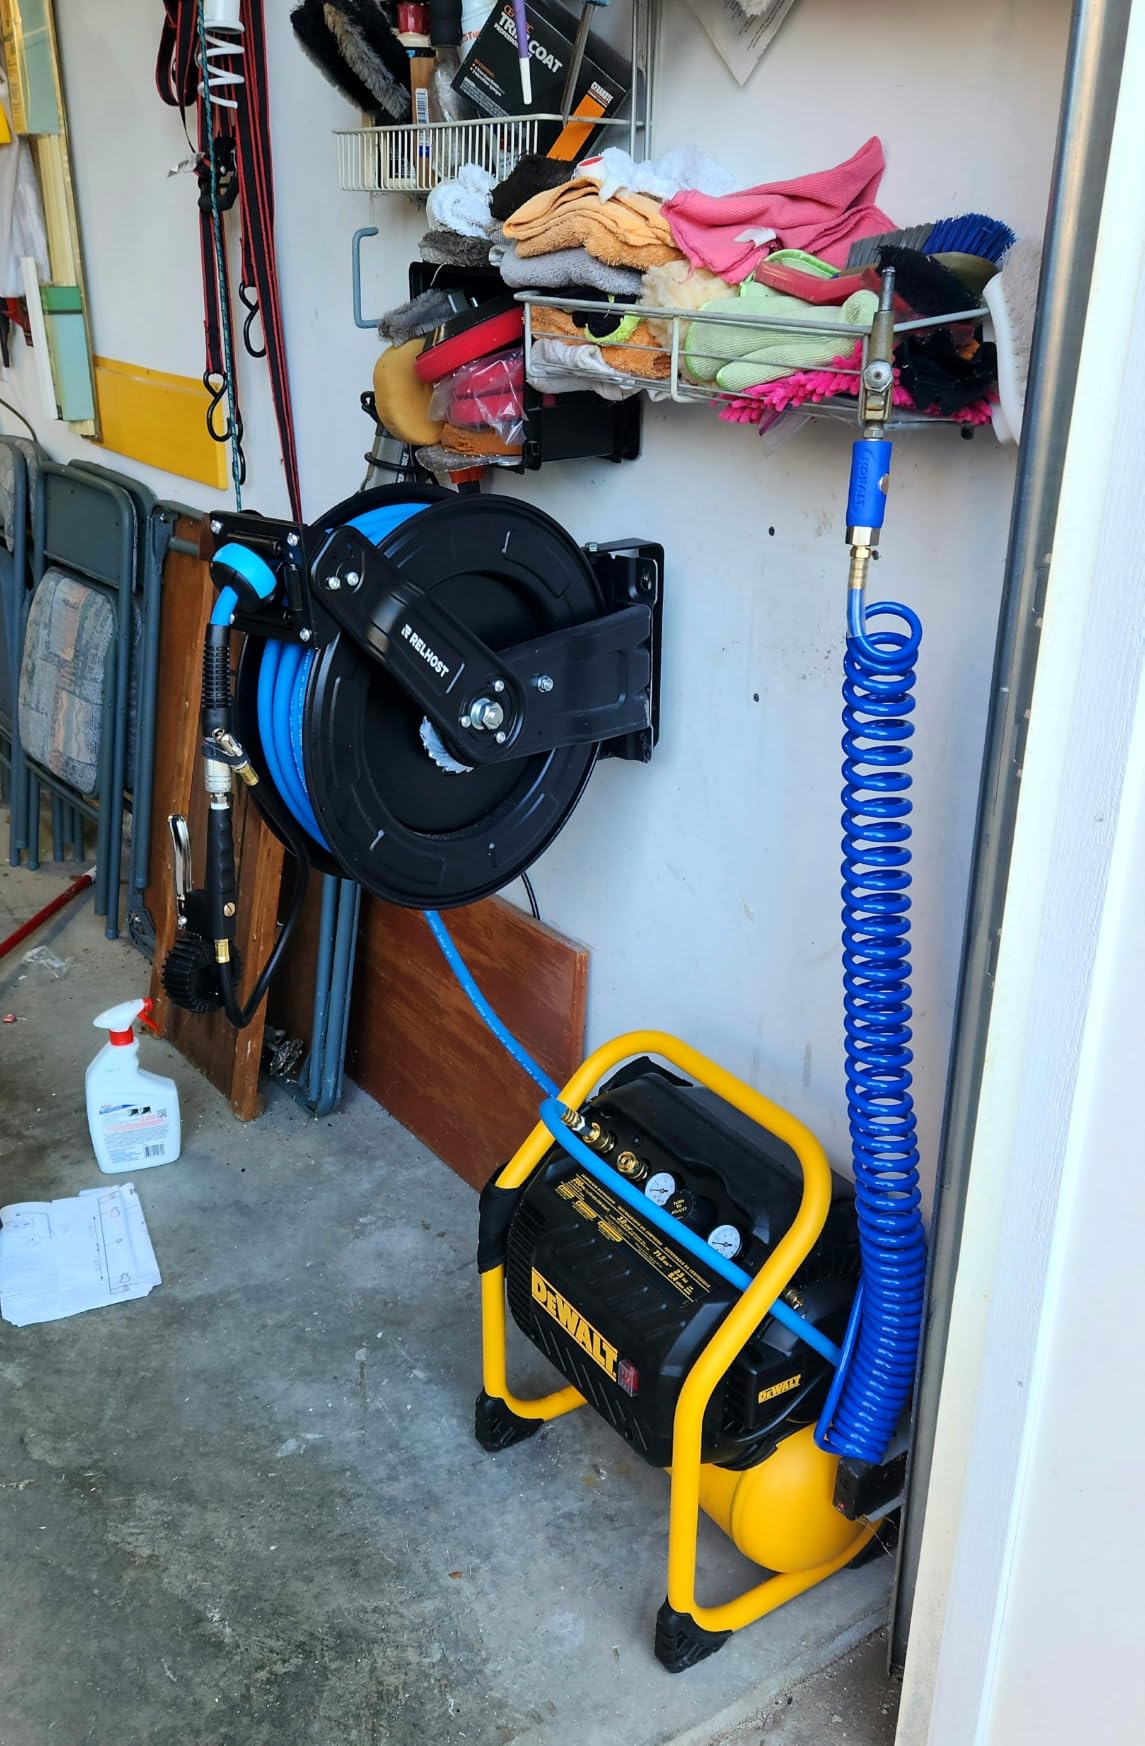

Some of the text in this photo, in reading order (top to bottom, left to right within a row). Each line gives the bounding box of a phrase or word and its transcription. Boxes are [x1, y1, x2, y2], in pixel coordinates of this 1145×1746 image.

[529, 40, 563, 73] COAT
[409, 632, 450, 678] RELHOST
[652, 1249, 666, 1262] 71.5
[673, 1267, 685, 1279] 2.5
[533, 1277, 617, 1375] DEWALT
[760, 1376, 800, 1401] DEWALT
